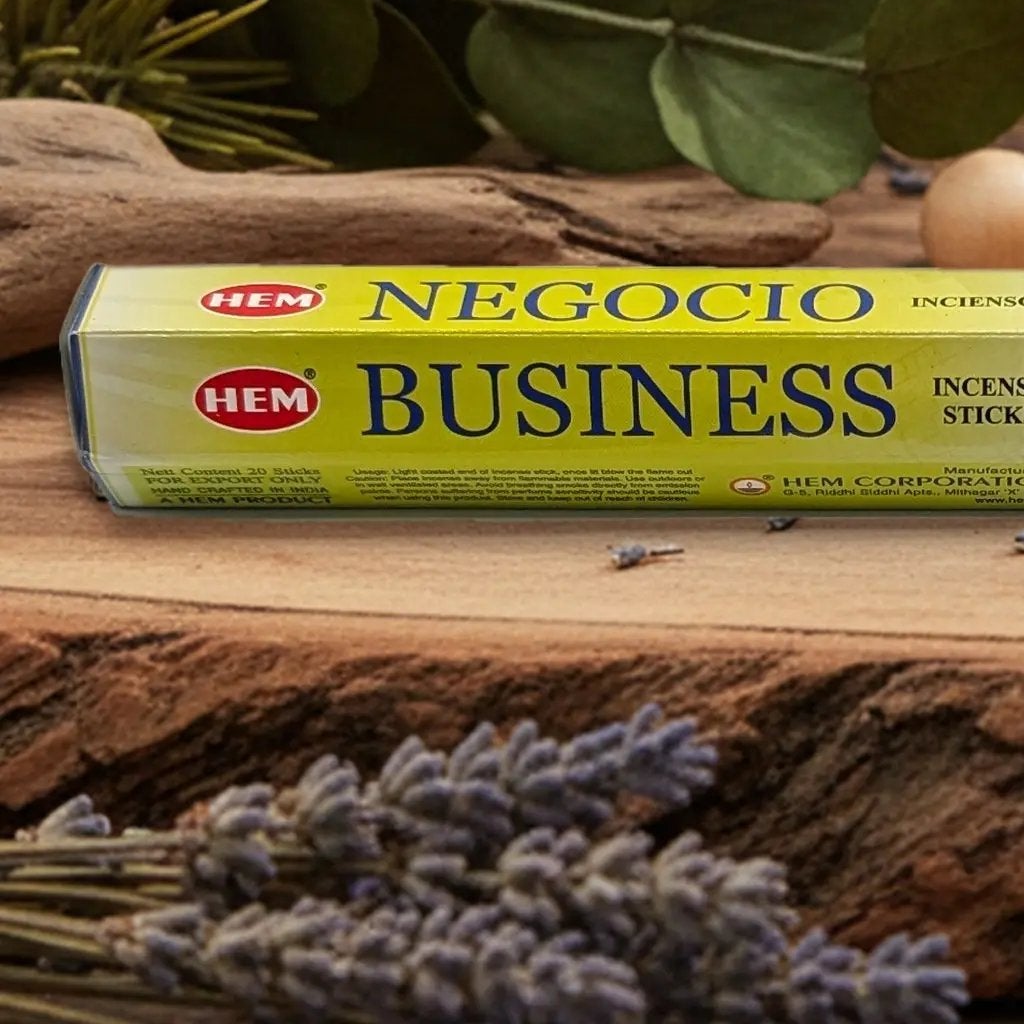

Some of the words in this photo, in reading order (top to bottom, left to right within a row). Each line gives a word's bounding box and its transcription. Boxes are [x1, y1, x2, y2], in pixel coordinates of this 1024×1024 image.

[208, 292, 315, 309] HEM
[359, 280, 875, 322] NEGOCIO
[203, 386, 310, 414] HEM
[356, 362, 898, 438] BUSINESS
[140, 467, 175, 476] Nett
[180, 467, 242, 476] Content
[248, 467, 267, 476] 20
[272, 467, 321, 476] Sticks
[144, 476, 184, 484] FOR
[189, 476, 264, 484] EXPORT
[270, 476, 321, 484] ONLY
[783, 477, 844, 487] HEM
[815, 488, 856, 496] Riddhi
[860, 488, 900, 496] Siddhi
[160, 496, 173, 504] A
[178, 496, 226, 504] HEM
[232, 496, 331, 504] PRODUCT
